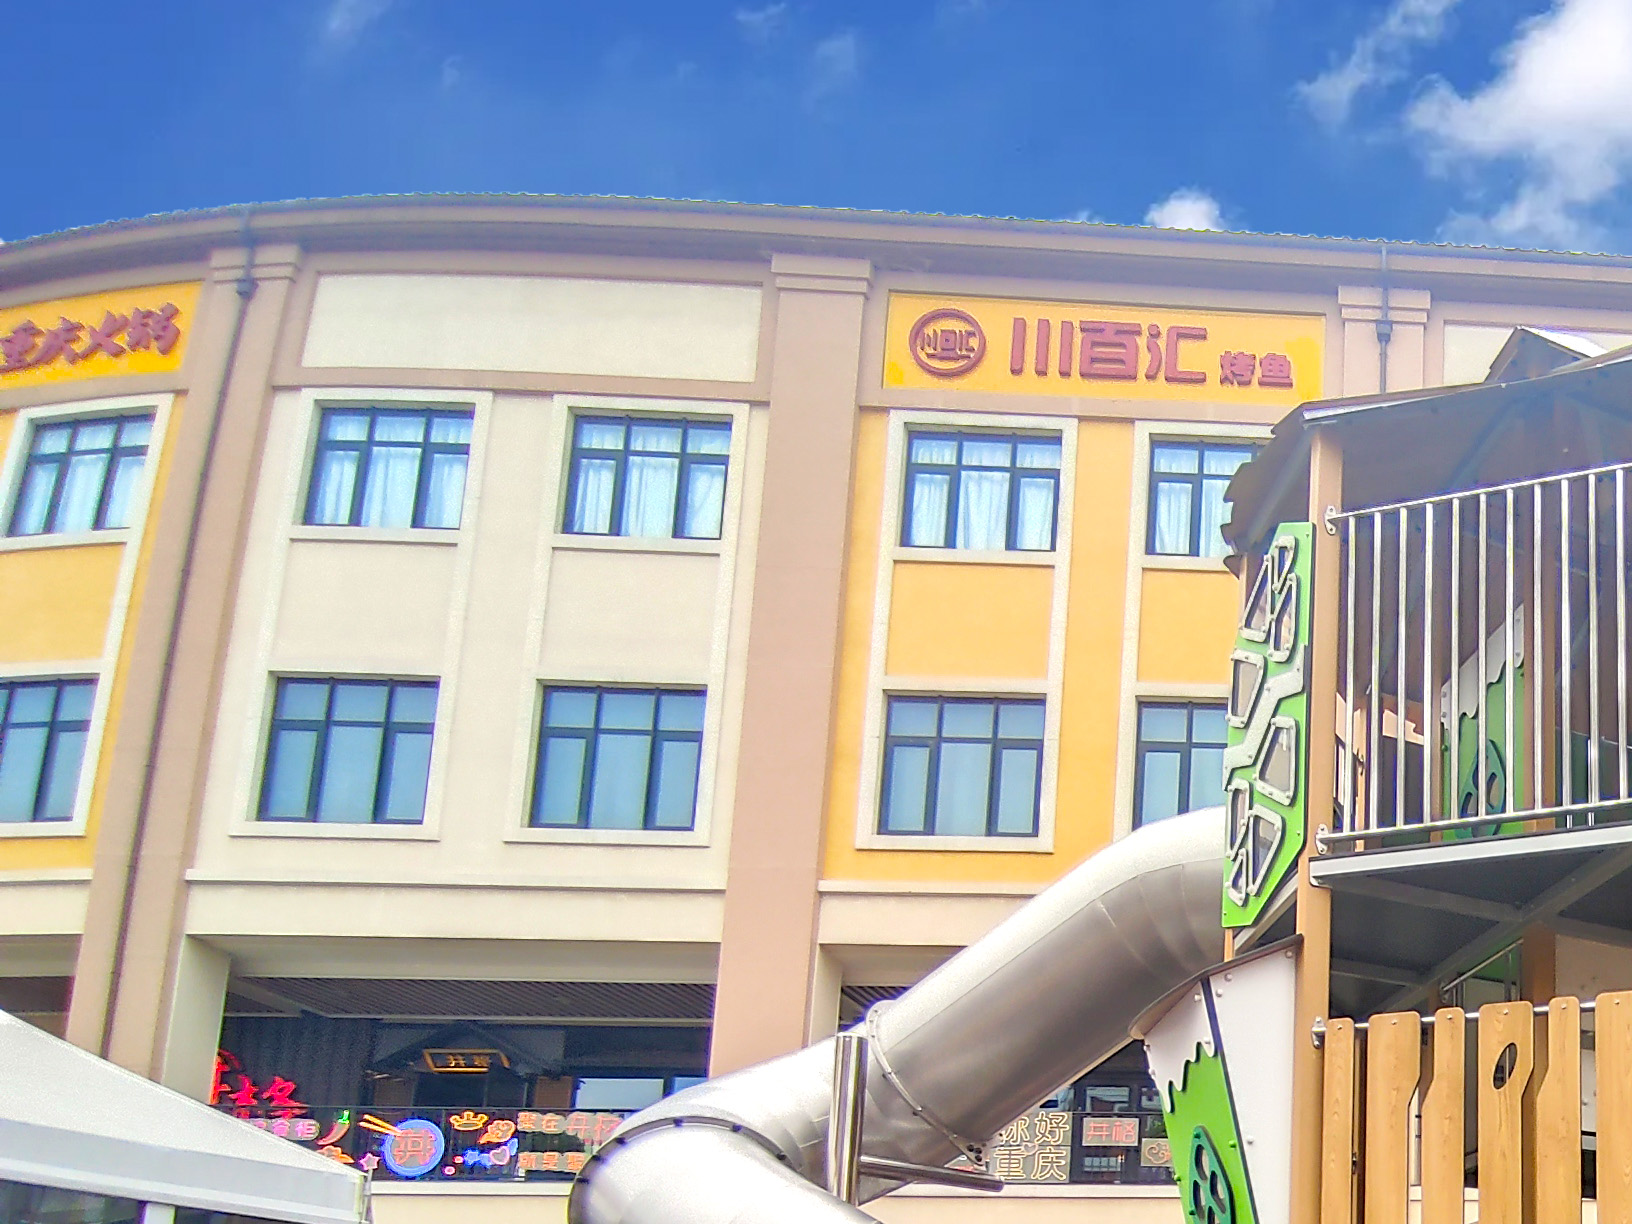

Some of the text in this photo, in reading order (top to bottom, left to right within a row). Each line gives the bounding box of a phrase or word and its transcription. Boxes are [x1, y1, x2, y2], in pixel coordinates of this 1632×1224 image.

[1009, 315, 1208, 384] 川百汇
[1219, 350, 1295, 388] 烤鱼
[1002, 1112, 1070, 1145] 你好
[1086, 1120, 1137, 1144] 井格
[993, 1146, 1067, 1181] 重庆
